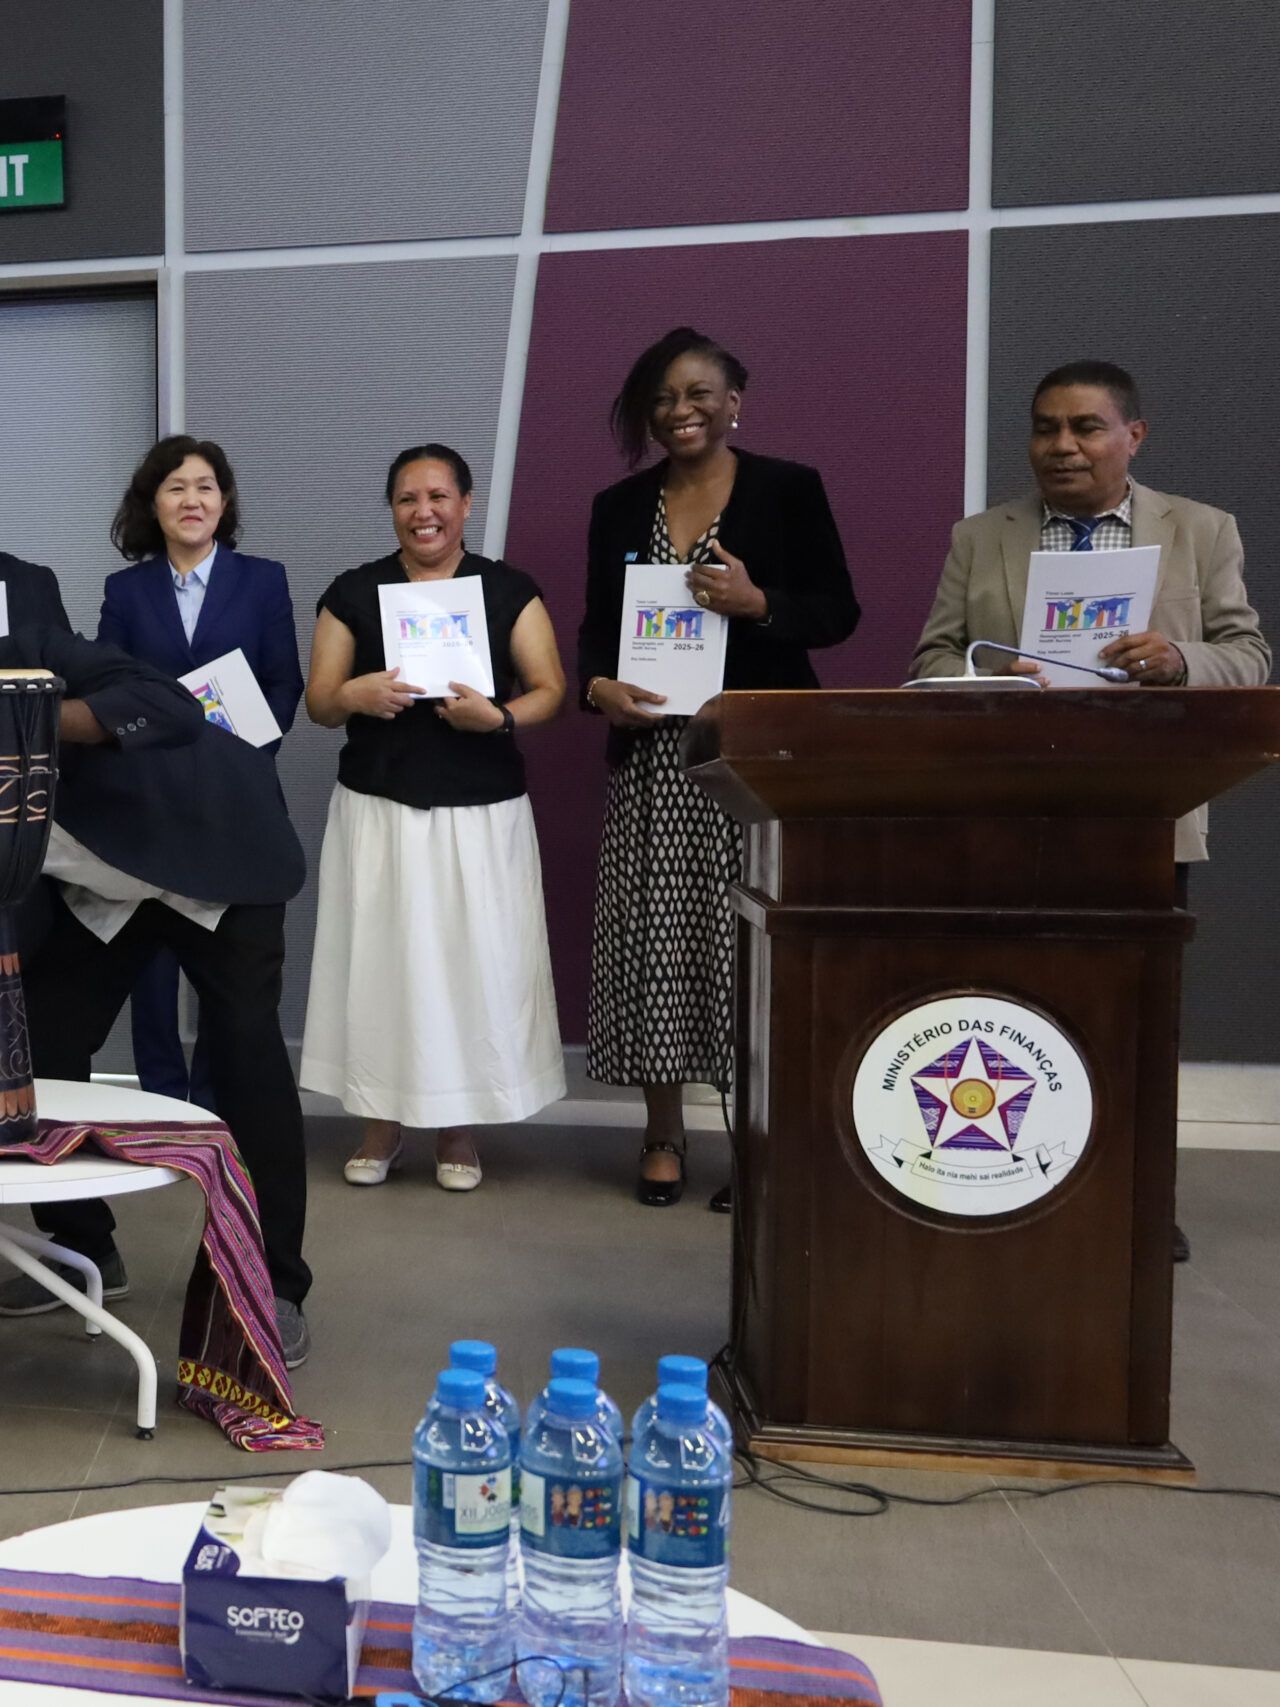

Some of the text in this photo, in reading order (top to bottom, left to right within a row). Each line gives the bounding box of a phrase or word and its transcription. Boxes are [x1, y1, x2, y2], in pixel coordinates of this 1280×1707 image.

[882, 1019, 1062, 1092] MINISTÉRIO DAS FINANÇAS
[936, 1167, 946, 1177] ita
[946, 1169, 959, 1180] nia
[979, 1172, 991, 1181] sai
[991, 1166, 1025, 1179] realidade
